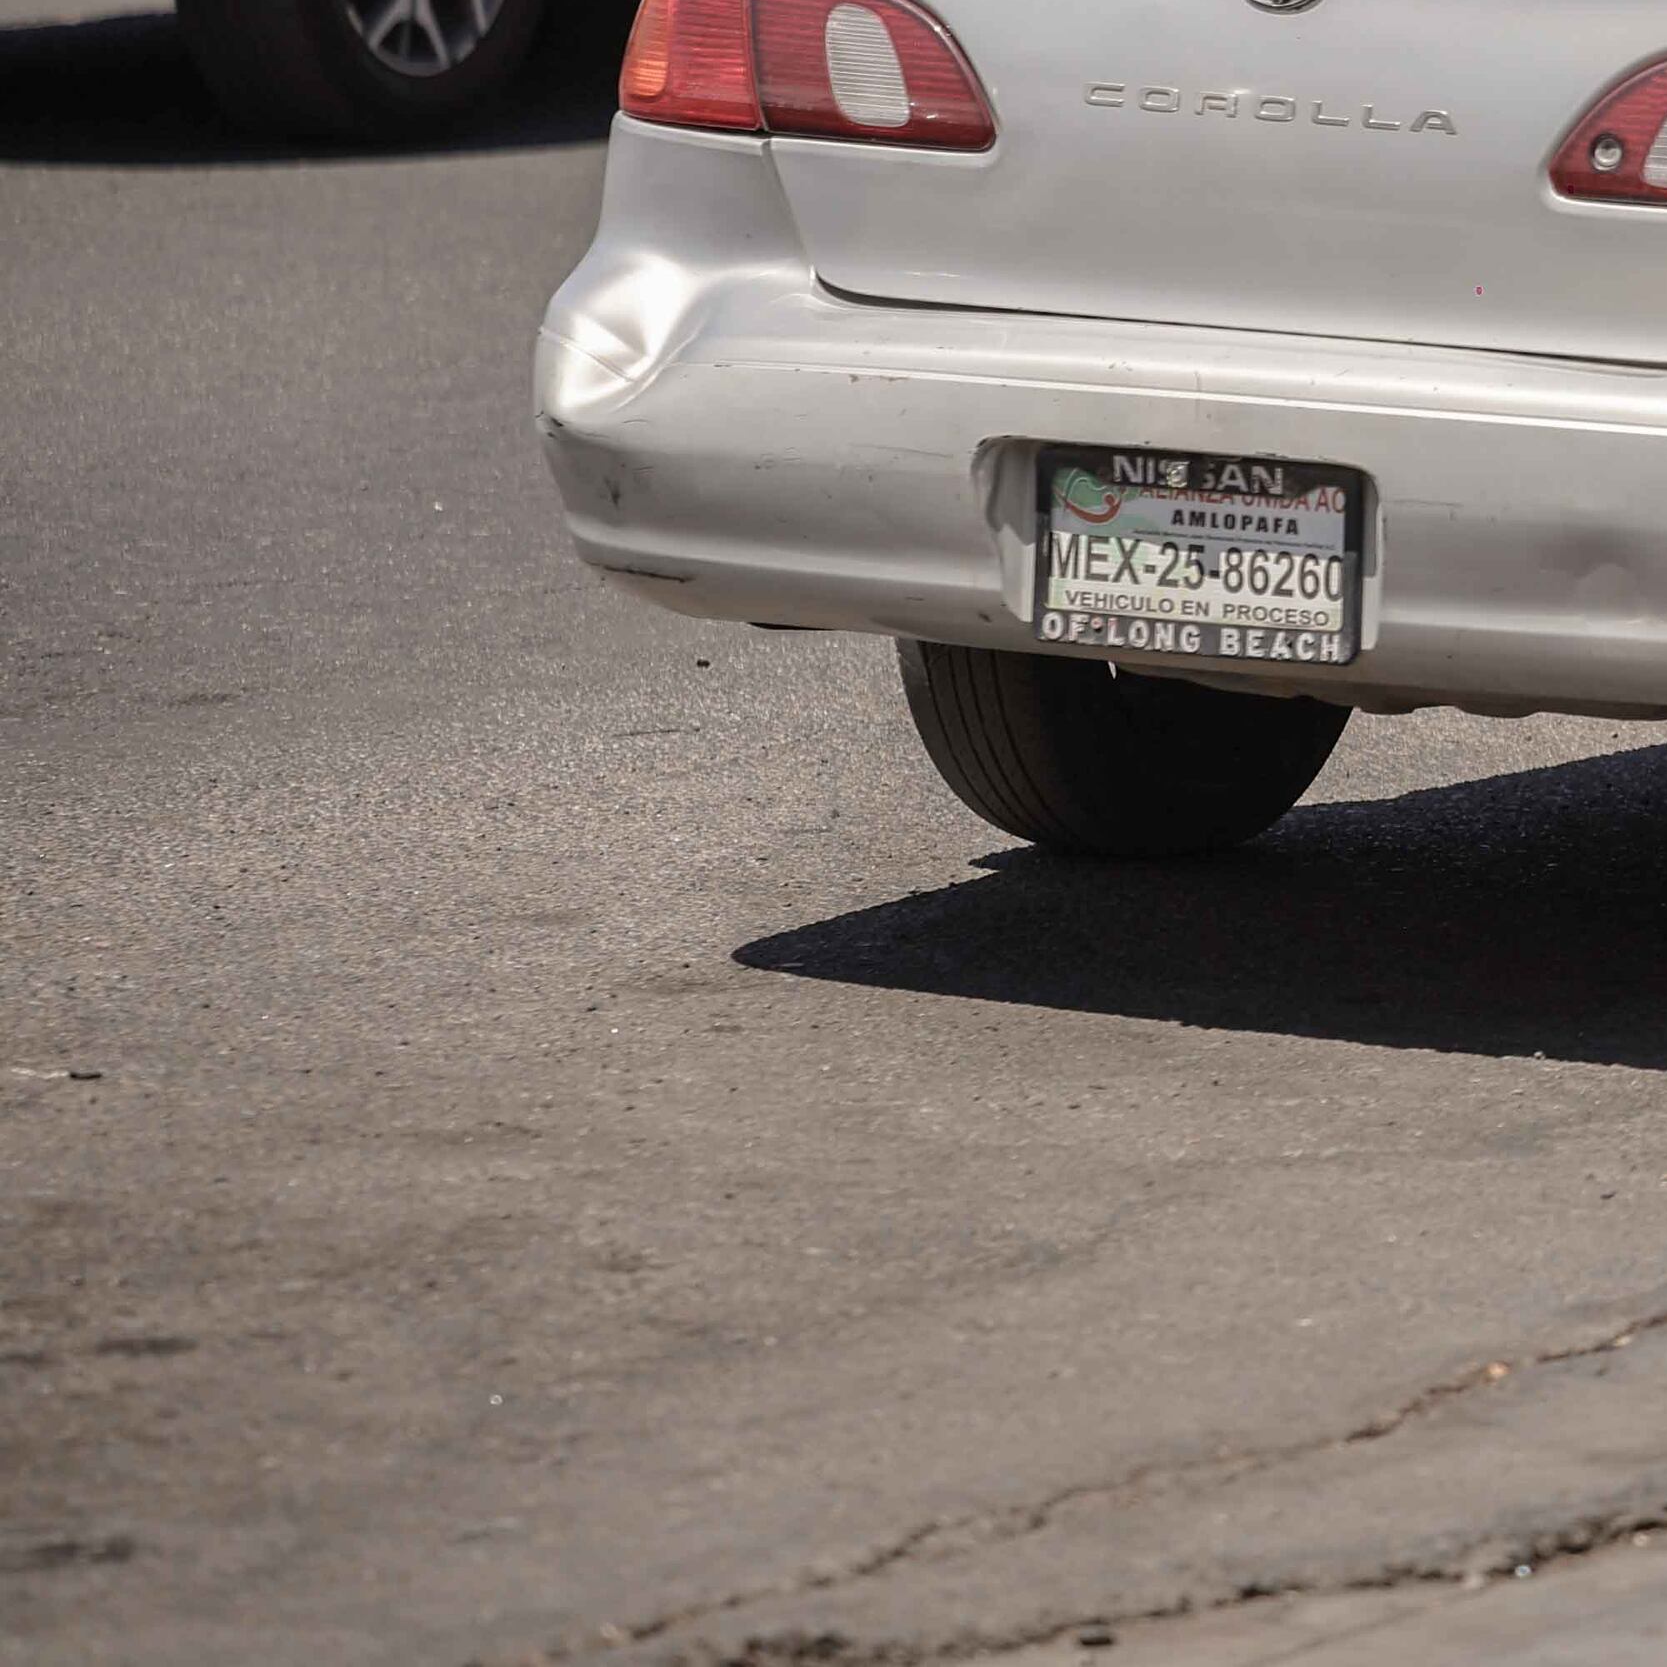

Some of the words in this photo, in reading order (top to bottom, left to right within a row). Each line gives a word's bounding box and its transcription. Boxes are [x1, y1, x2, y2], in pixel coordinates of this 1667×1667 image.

[1083, 81, 1459, 136] COROLLA
[1171, 509, 1299, 536] AMLOPAFA
[1049, 532, 1345, 602] MEX-25-86260
[1065, 589, 1176, 614] VEHICULO
[1181, 599, 1211, 617] EN
[1221, 603, 1330, 627] PROCESO
[1106, 616, 1201, 654] LONG
[1218, 627, 1342, 663] BEACH
